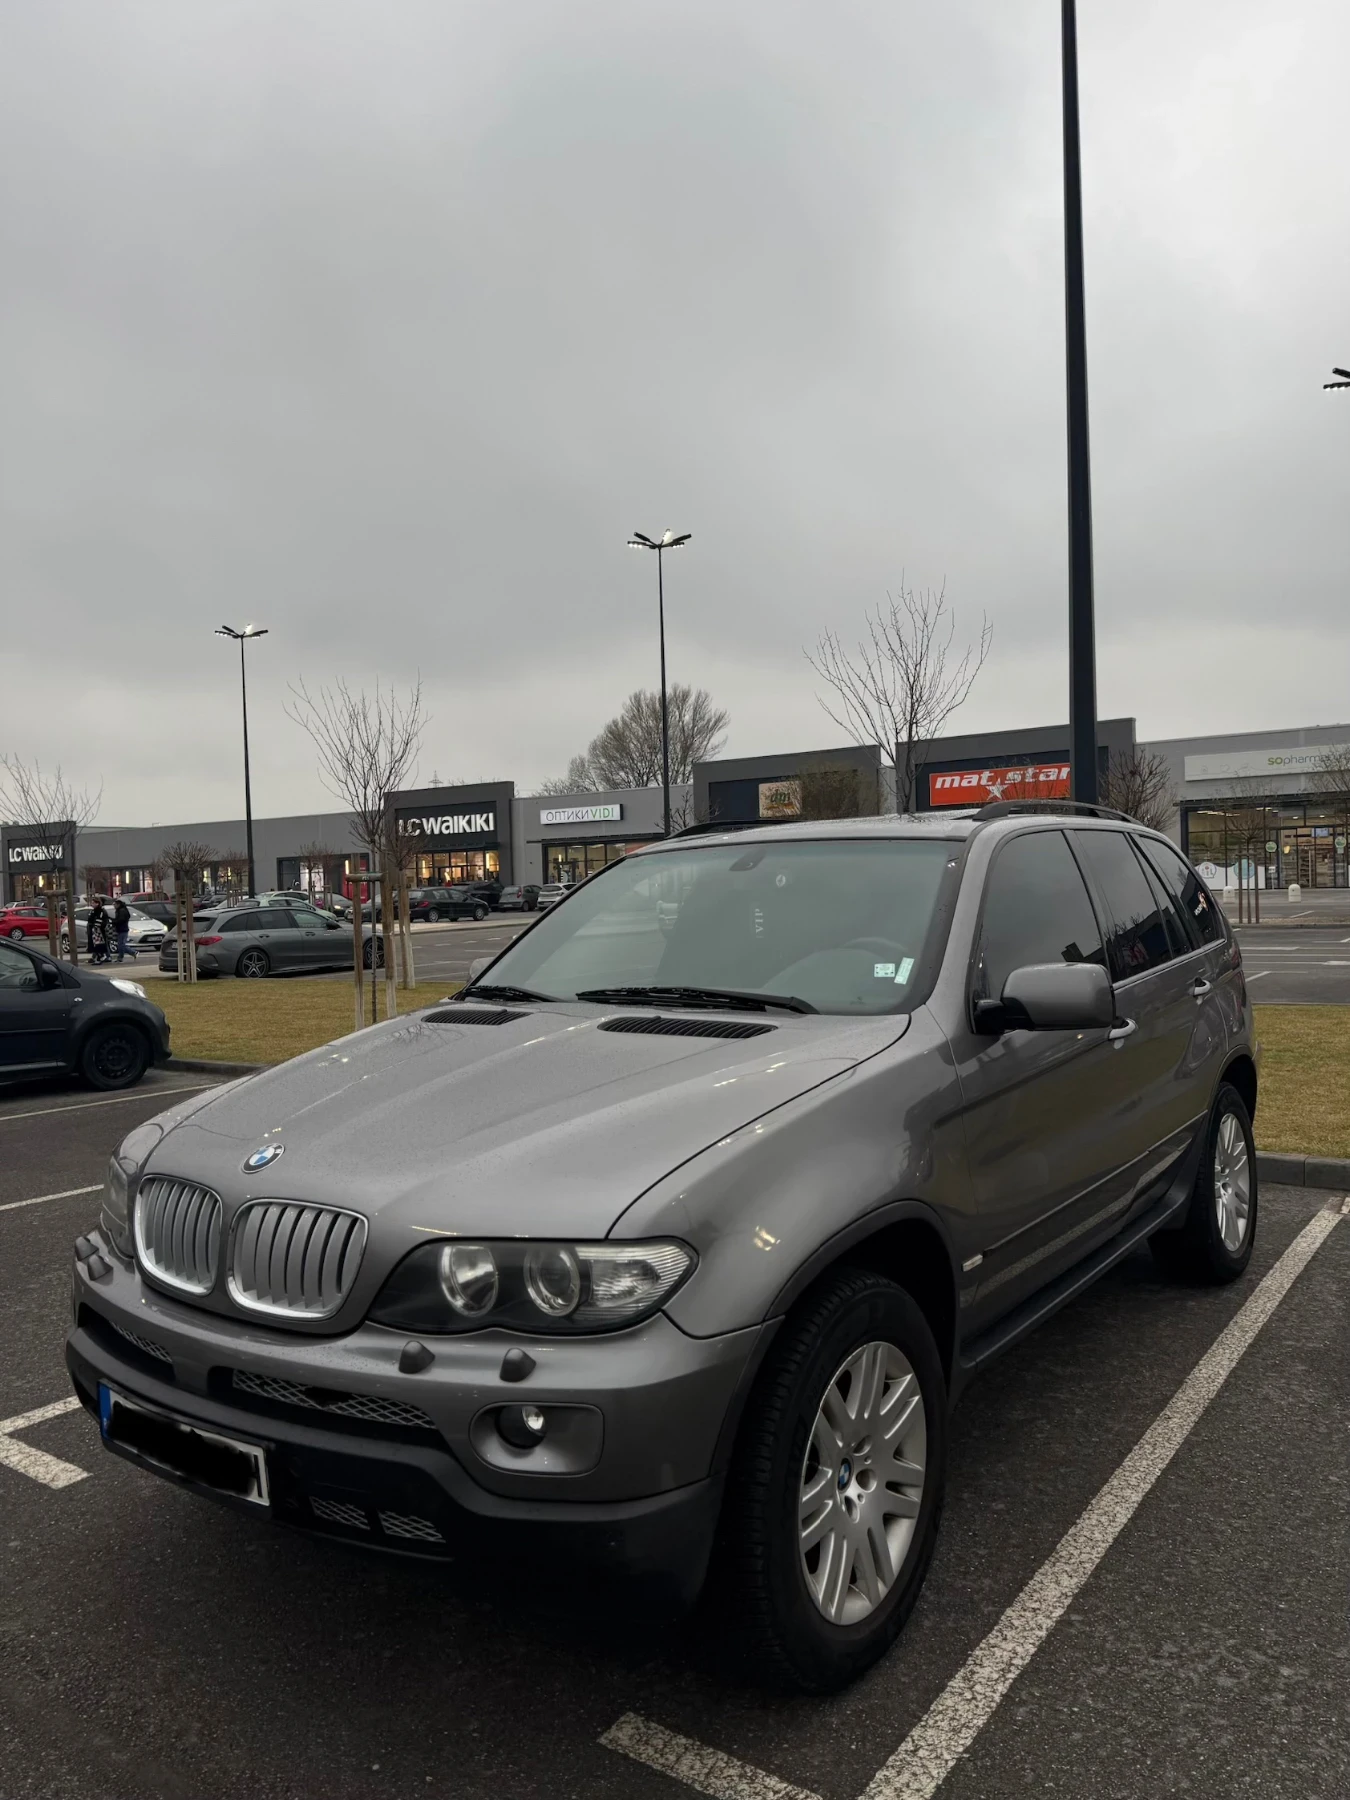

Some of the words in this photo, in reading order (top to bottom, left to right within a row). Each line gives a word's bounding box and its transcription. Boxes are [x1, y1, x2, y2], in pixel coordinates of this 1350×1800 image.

[934, 770, 994, 789] mat
[1005, 767, 1070, 784] star
[546, 809, 589, 822] ОПТИКИ
[590, 807, 614, 819] VIDI
[398, 818, 421, 836] LC
[9, 847, 22, 863] LC
